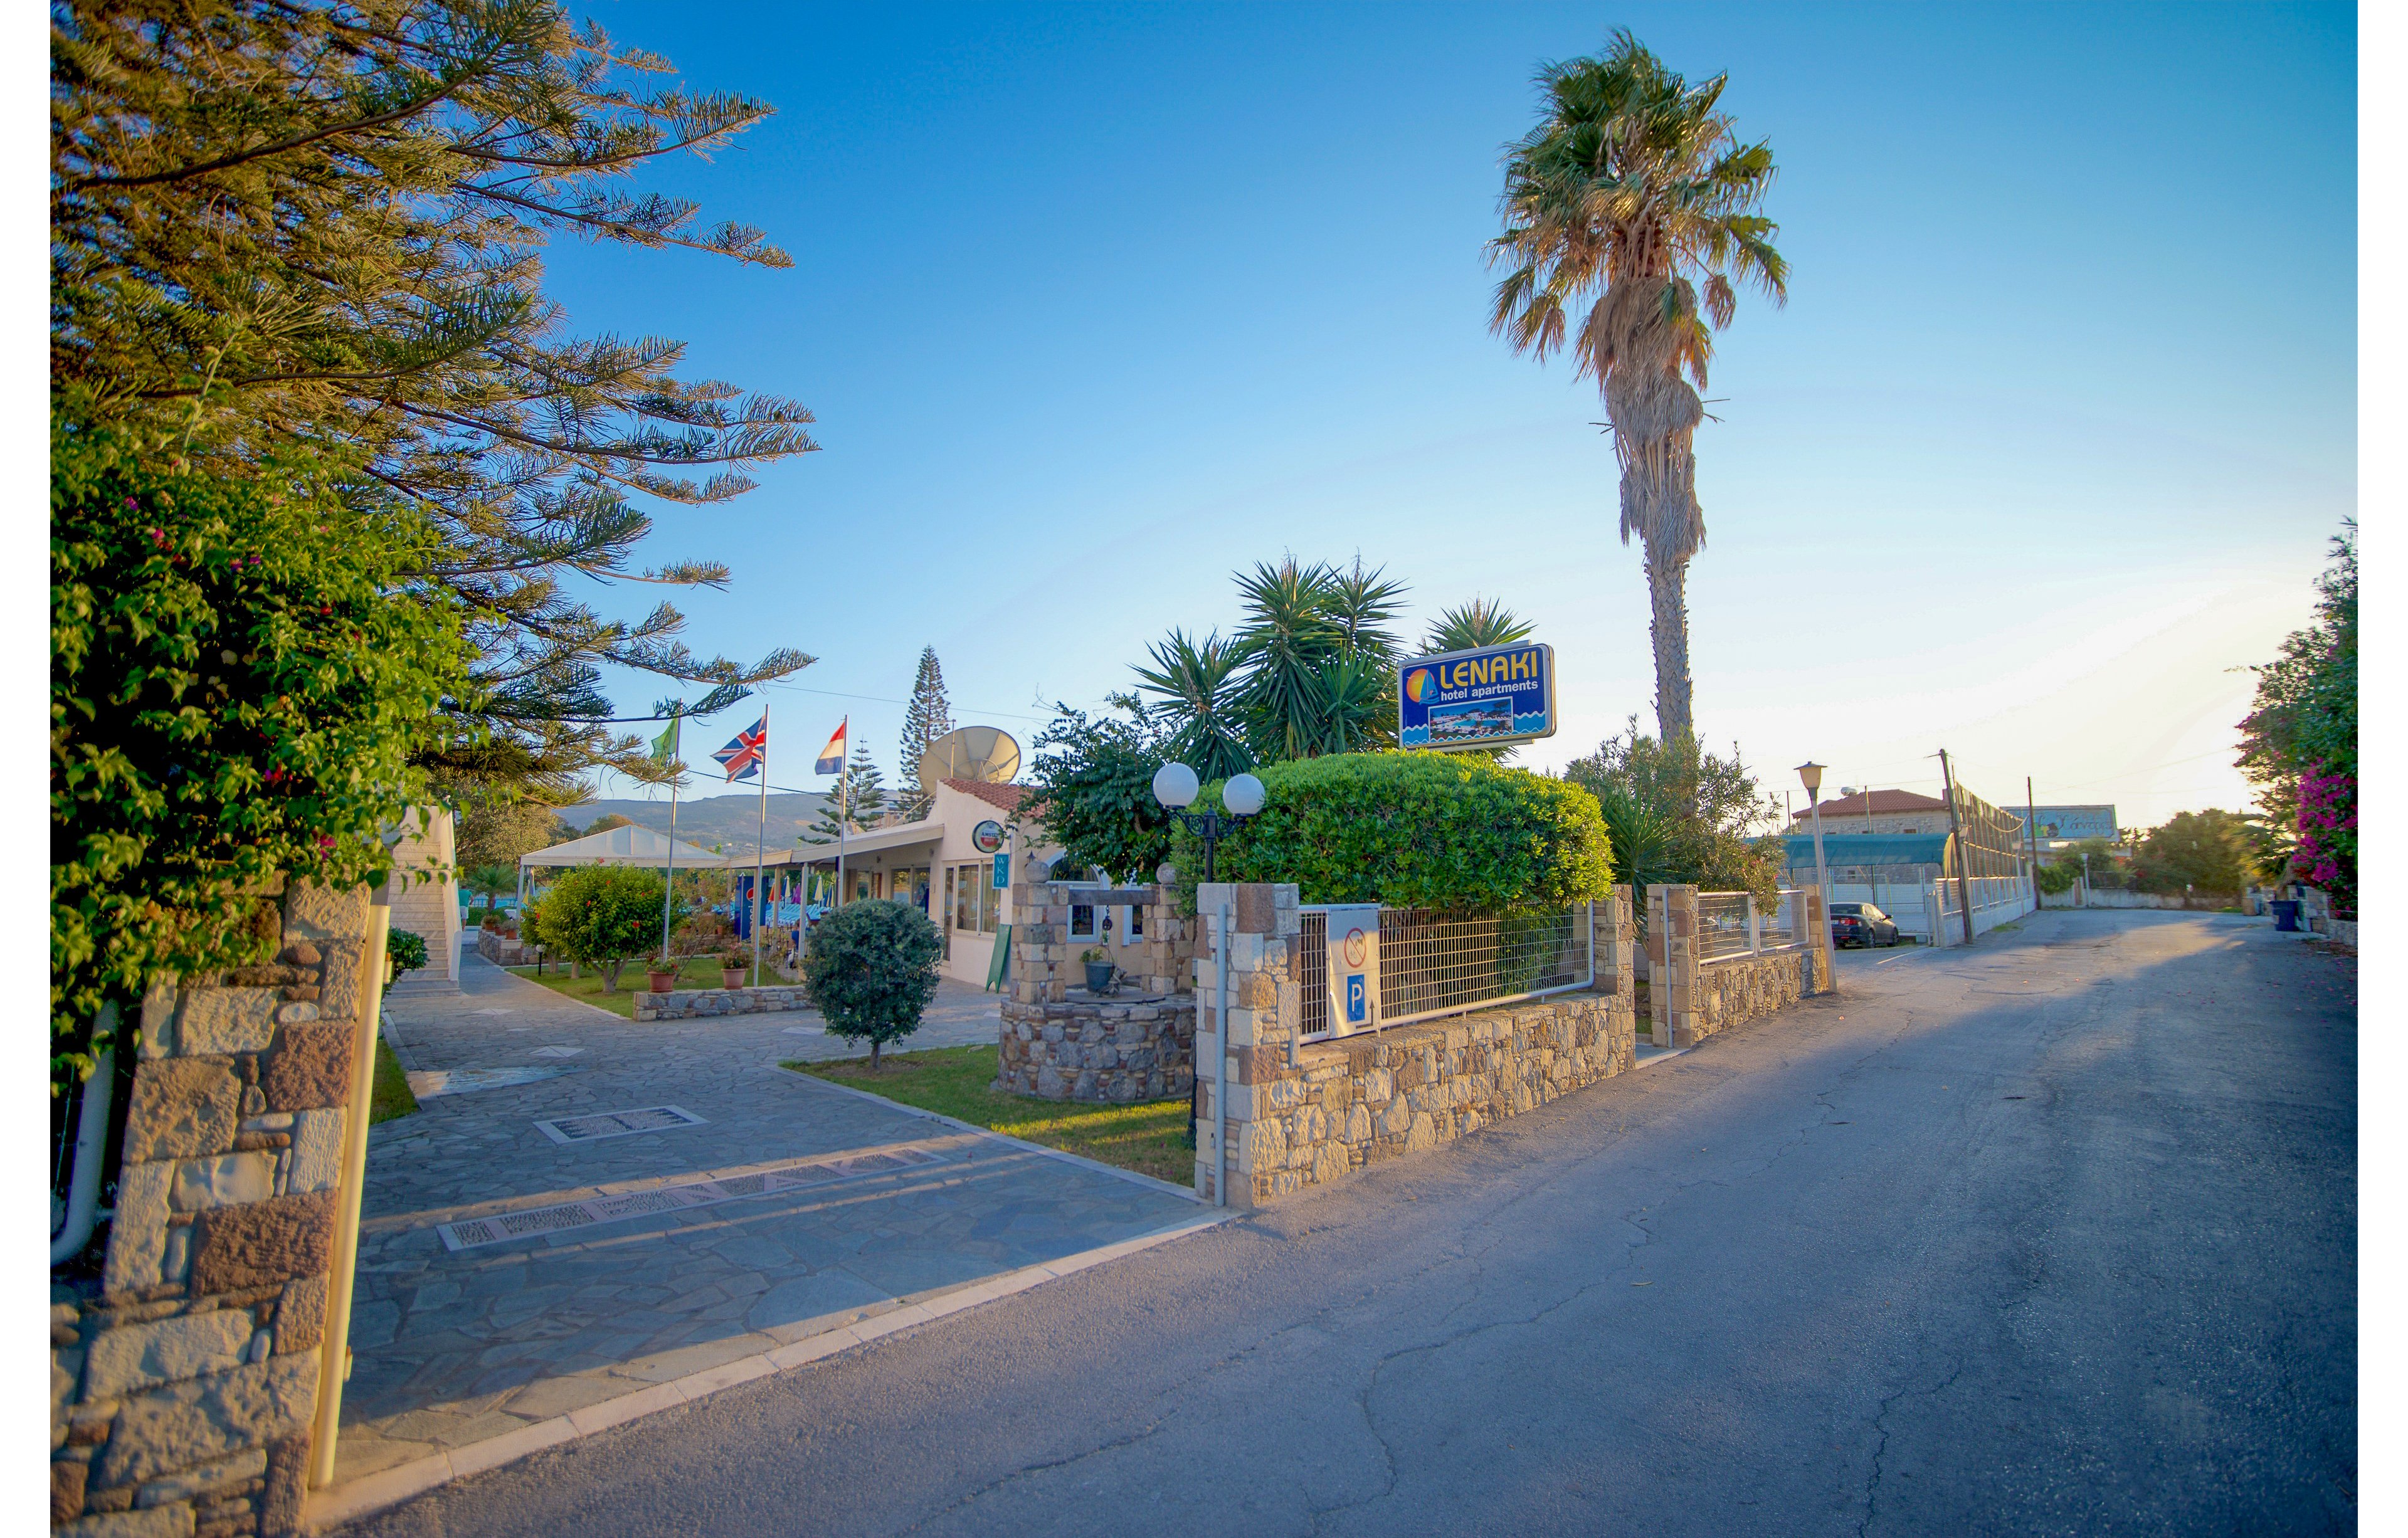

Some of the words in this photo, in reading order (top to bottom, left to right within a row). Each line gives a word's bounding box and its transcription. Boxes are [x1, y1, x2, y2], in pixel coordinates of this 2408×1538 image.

[1440, 651, 1537, 690] LENAKI
[1441, 688, 1467, 701] hotel
[1472, 680, 1538, 698] apartments
[996, 857, 1006, 884] WKD
[1351, 983, 1363, 1012] P
